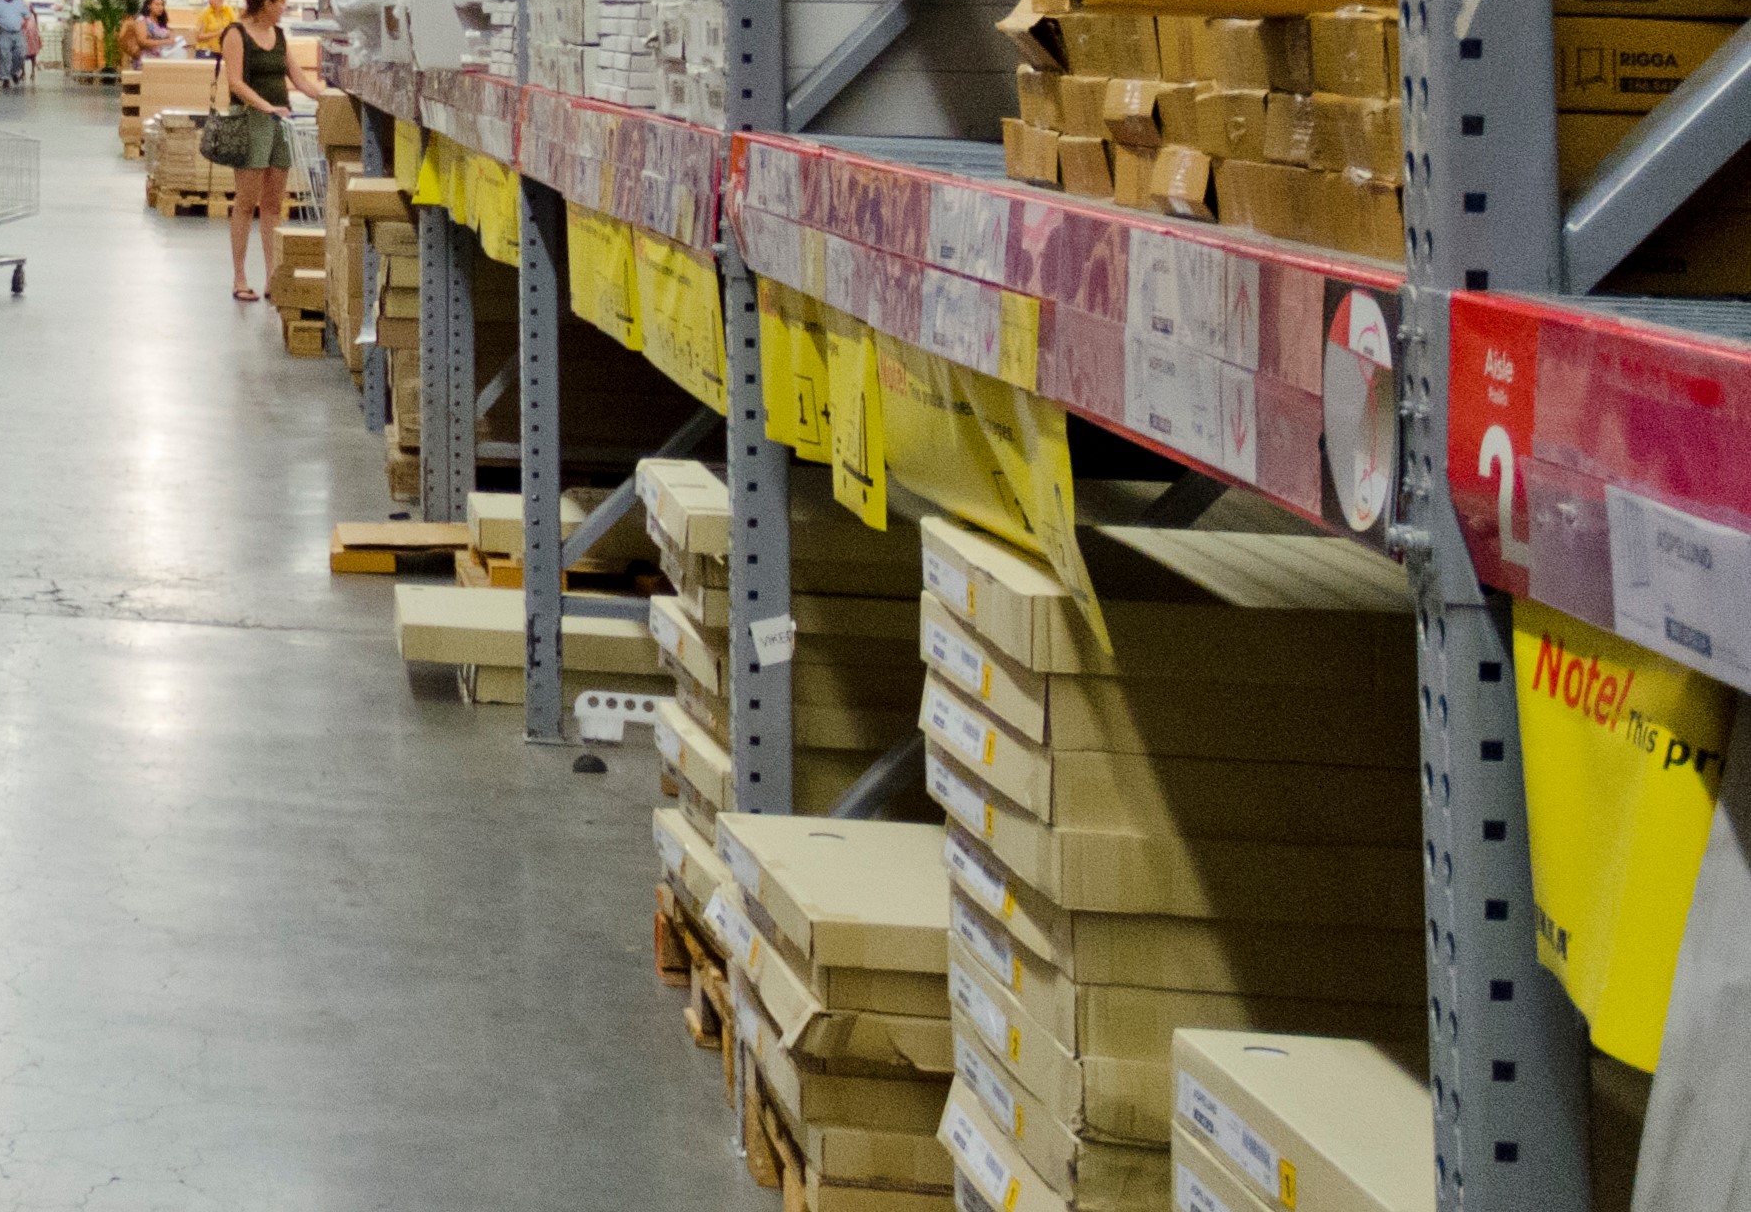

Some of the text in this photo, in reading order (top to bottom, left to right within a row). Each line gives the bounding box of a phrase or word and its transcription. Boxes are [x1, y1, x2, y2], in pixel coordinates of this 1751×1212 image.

[1619, 52, 1679, 68] RIGGA
[1484, 347, 1515, 383] Aisle
[1478, 424, 1531, 569] 2
[1531, 631, 1635, 732] Note!
[1626, 707, 1659, 754] This
